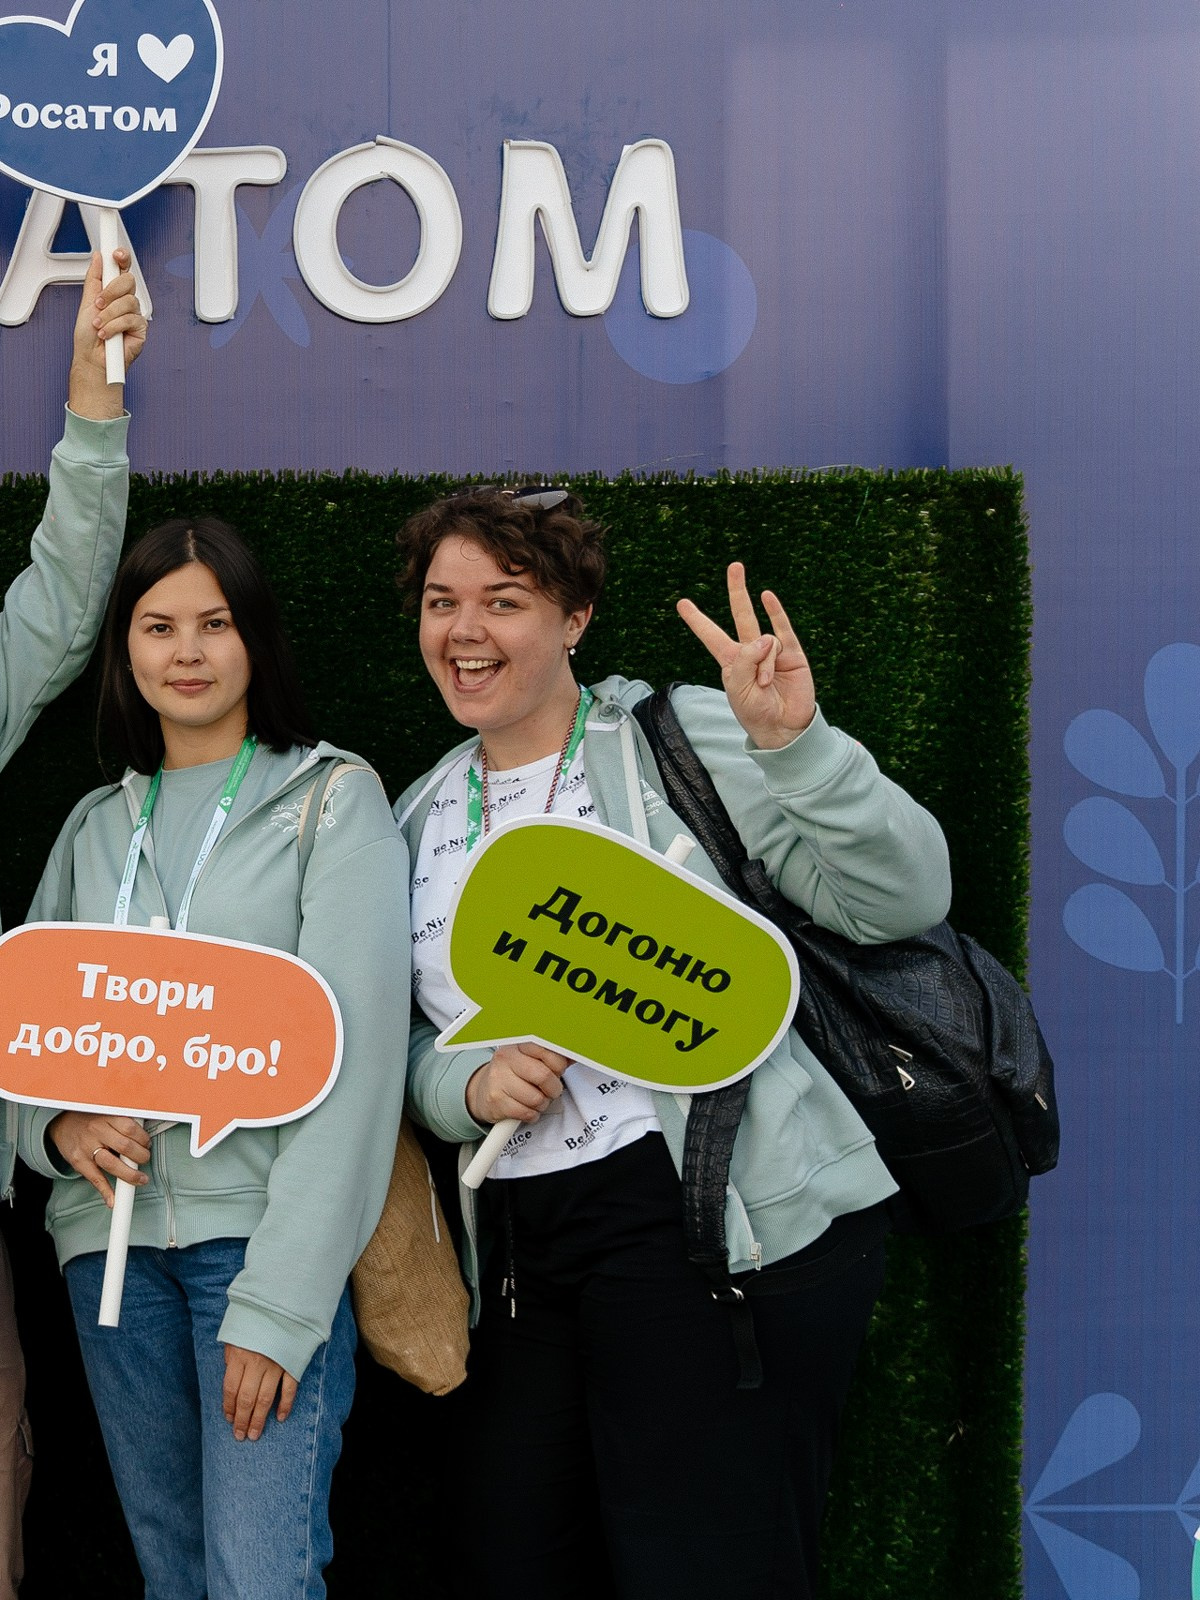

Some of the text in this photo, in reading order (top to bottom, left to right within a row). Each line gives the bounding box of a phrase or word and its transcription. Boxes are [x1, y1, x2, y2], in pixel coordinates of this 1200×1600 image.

[86, 42, 118, 77] Я
[498, 787, 527, 806] Nice
[577, 804, 596, 818] Be
[411, 928, 427, 944] Be
[527, 886, 732, 994] Догоню
[76, 962, 216, 1016] Твори
[491, 930, 720, 1053] и помогу
[7, 1022, 282, 1080] добро, бро!
[596, 1079, 619, 1096] Be
[563, 1134, 584, 1151] Be
